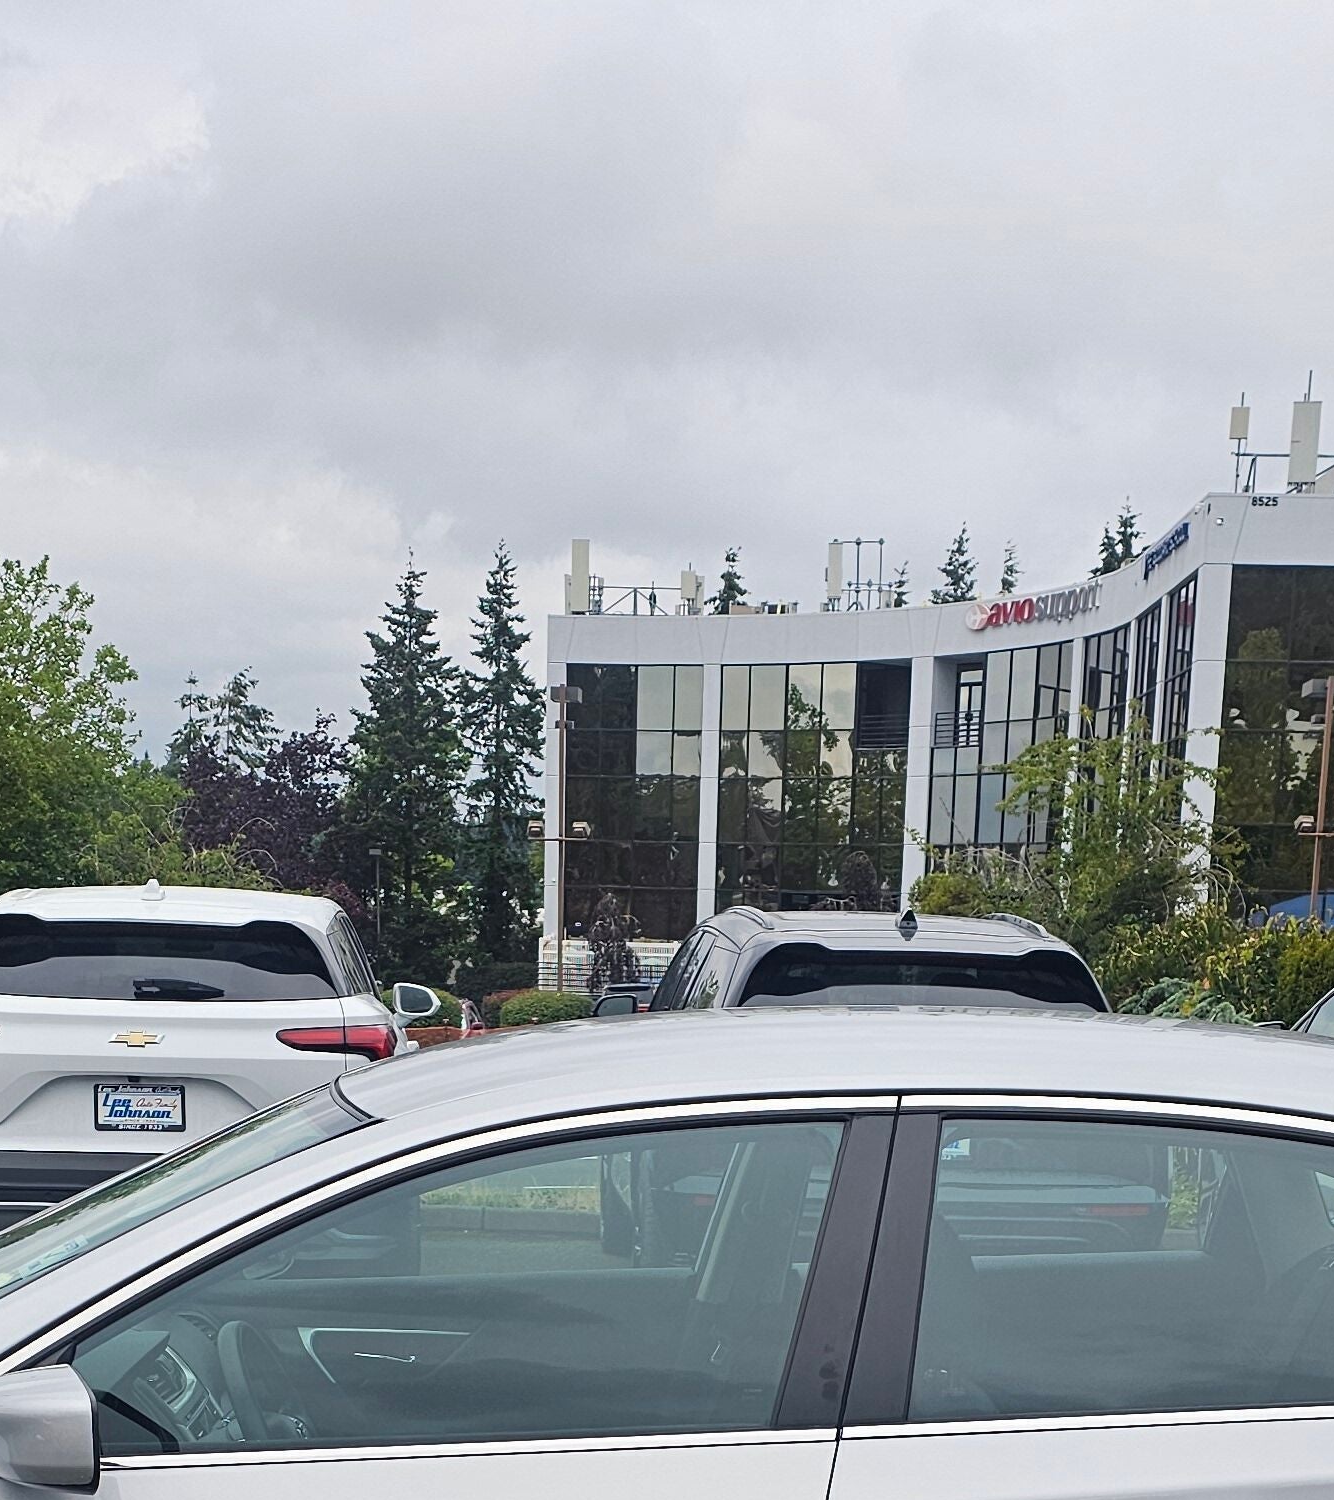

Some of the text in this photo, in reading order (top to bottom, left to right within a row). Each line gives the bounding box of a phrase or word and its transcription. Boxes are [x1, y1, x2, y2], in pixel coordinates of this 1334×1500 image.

[1251, 496, 1279, 507] 8525
[102, 1093, 133, 1108] Lee
[104, 1106, 173, 1119] Johnson
